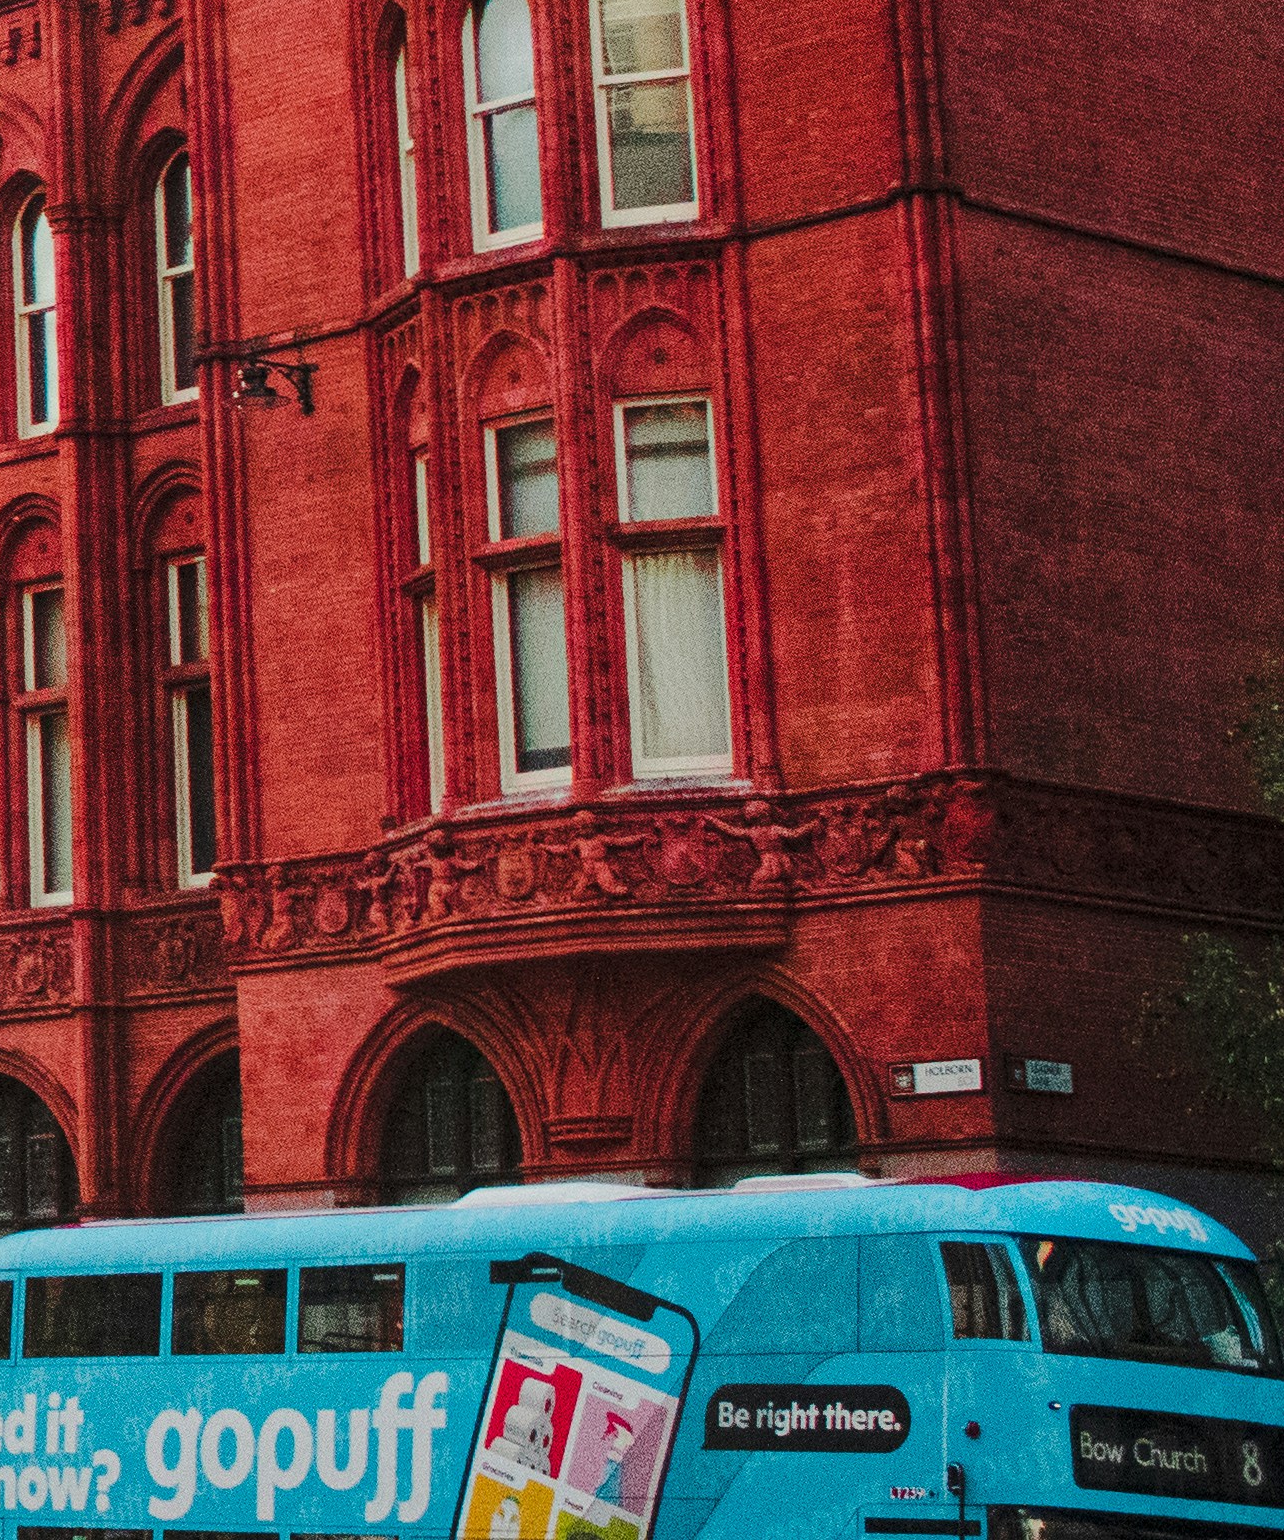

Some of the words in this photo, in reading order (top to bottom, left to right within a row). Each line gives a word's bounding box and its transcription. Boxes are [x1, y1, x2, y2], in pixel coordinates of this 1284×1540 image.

[925, 1064, 973, 1076] HOLBORN
[1108, 1203, 1208, 1242] gopuff
[551, 1306, 597, 1335] Search
[597, 1327, 646, 1359] gopuff
[592, 1382, 624, 1401] Cleaning
[46, 1392, 84, 1453] it
[718, 1401, 750, 1428] Be
[756, 1401, 819, 1436] right
[823, 1402, 901, 1431] there.
[145, 1371, 448, 1523] gopuff
[1081, 1431, 1123, 1463] Bow
[1133, 1438, 1207, 1473] Church
[1242, 1440, 1263, 1486] 8
